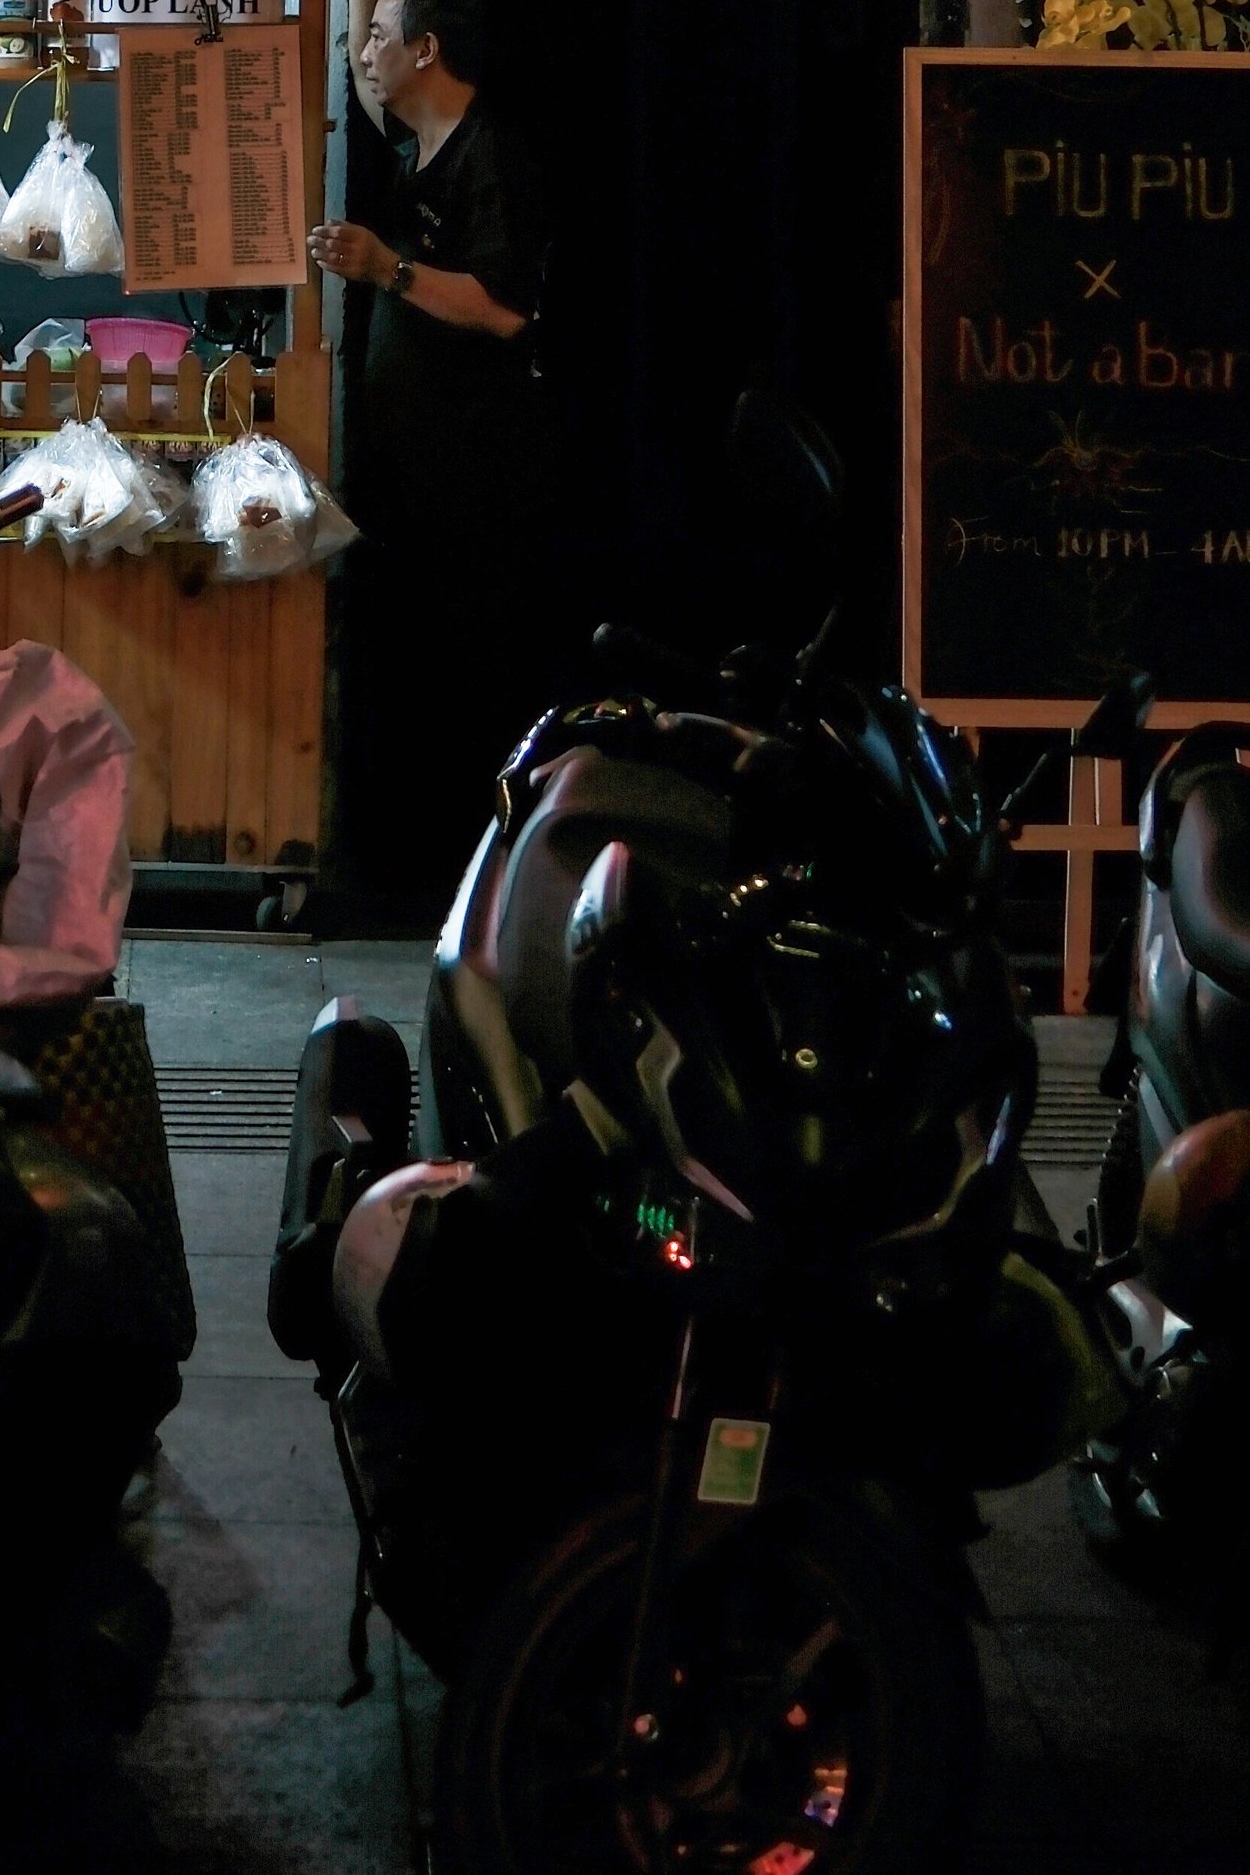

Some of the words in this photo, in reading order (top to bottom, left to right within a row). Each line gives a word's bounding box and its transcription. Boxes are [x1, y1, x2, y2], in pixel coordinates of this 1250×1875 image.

[956, 315, 1075, 385] Not
[1091, 340, 1127, 386] a
[1190, 526, 1250, 565] 4A
